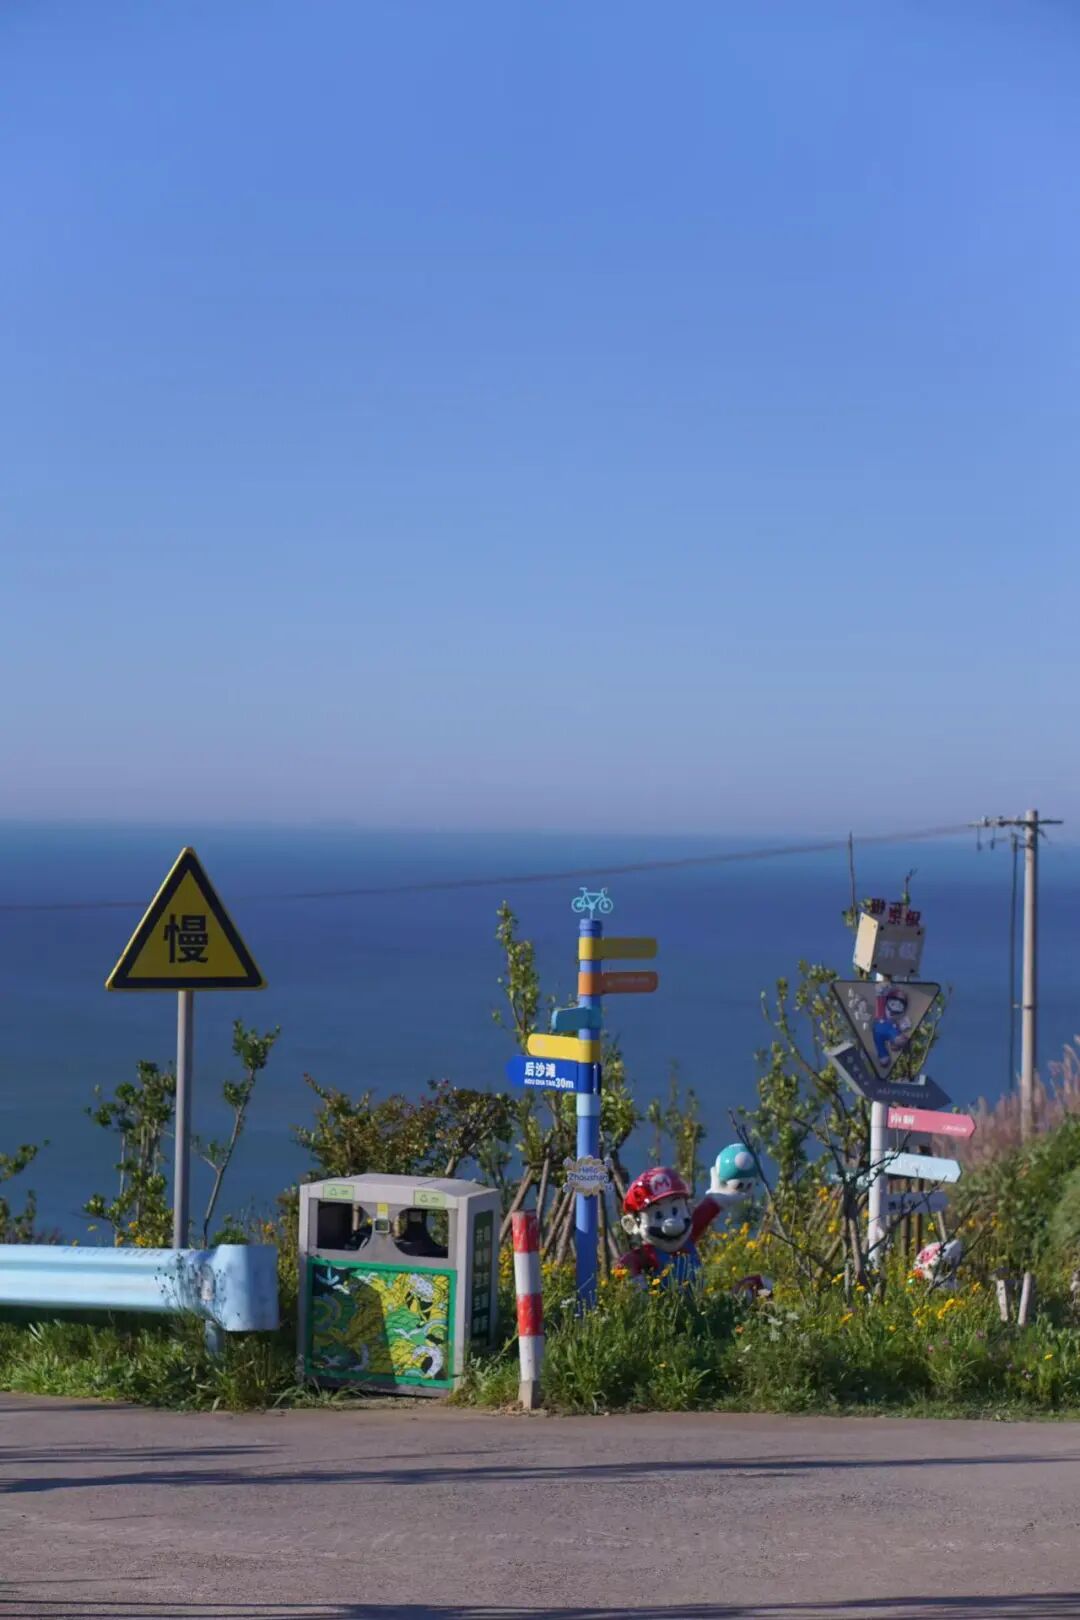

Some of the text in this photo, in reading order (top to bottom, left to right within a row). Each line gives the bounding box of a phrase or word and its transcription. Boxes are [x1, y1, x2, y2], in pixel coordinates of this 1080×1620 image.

[164, 914, 208, 963] 慢
[525, 1062, 556, 1077] 后沙滩
[555, 1077, 574, 1088] 30m
[654, 1178, 670, 1190] M
